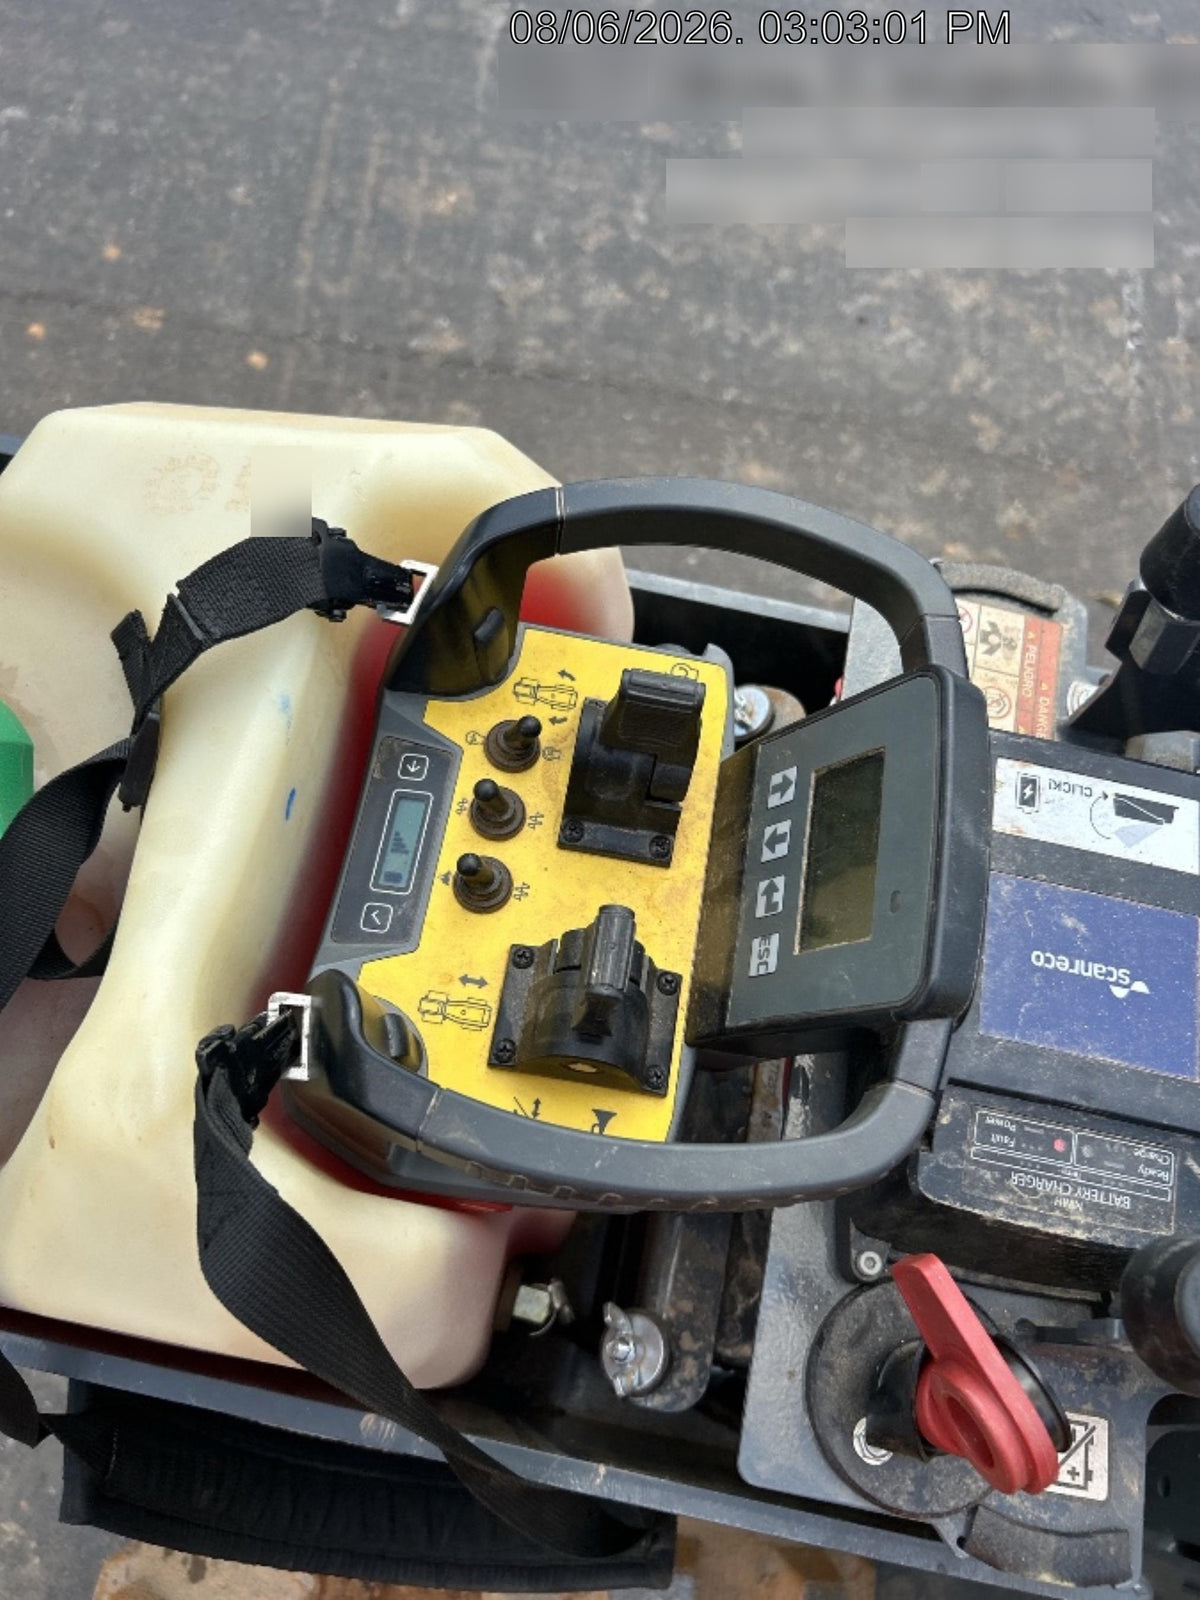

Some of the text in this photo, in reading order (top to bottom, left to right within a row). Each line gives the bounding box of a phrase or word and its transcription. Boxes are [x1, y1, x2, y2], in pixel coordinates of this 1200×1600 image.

[1021, 646, 1036, 698] PELIGRO
[1035, 696, 1050, 739] DANGE
[1048, 778, 1093, 798] CLICK!
[757, 936, 770, 975] ESC
[1030, 951, 1131, 985] scanreco
[985, 1115, 1016, 1132] Power
[990, 1133, 1015, 1147] Fault
[1133, 1147, 1170, 1164] Charge
[1138, 1164, 1169, 1181] Ready
[1011, 1170, 1131, 1210] BATTERY CHARGER
